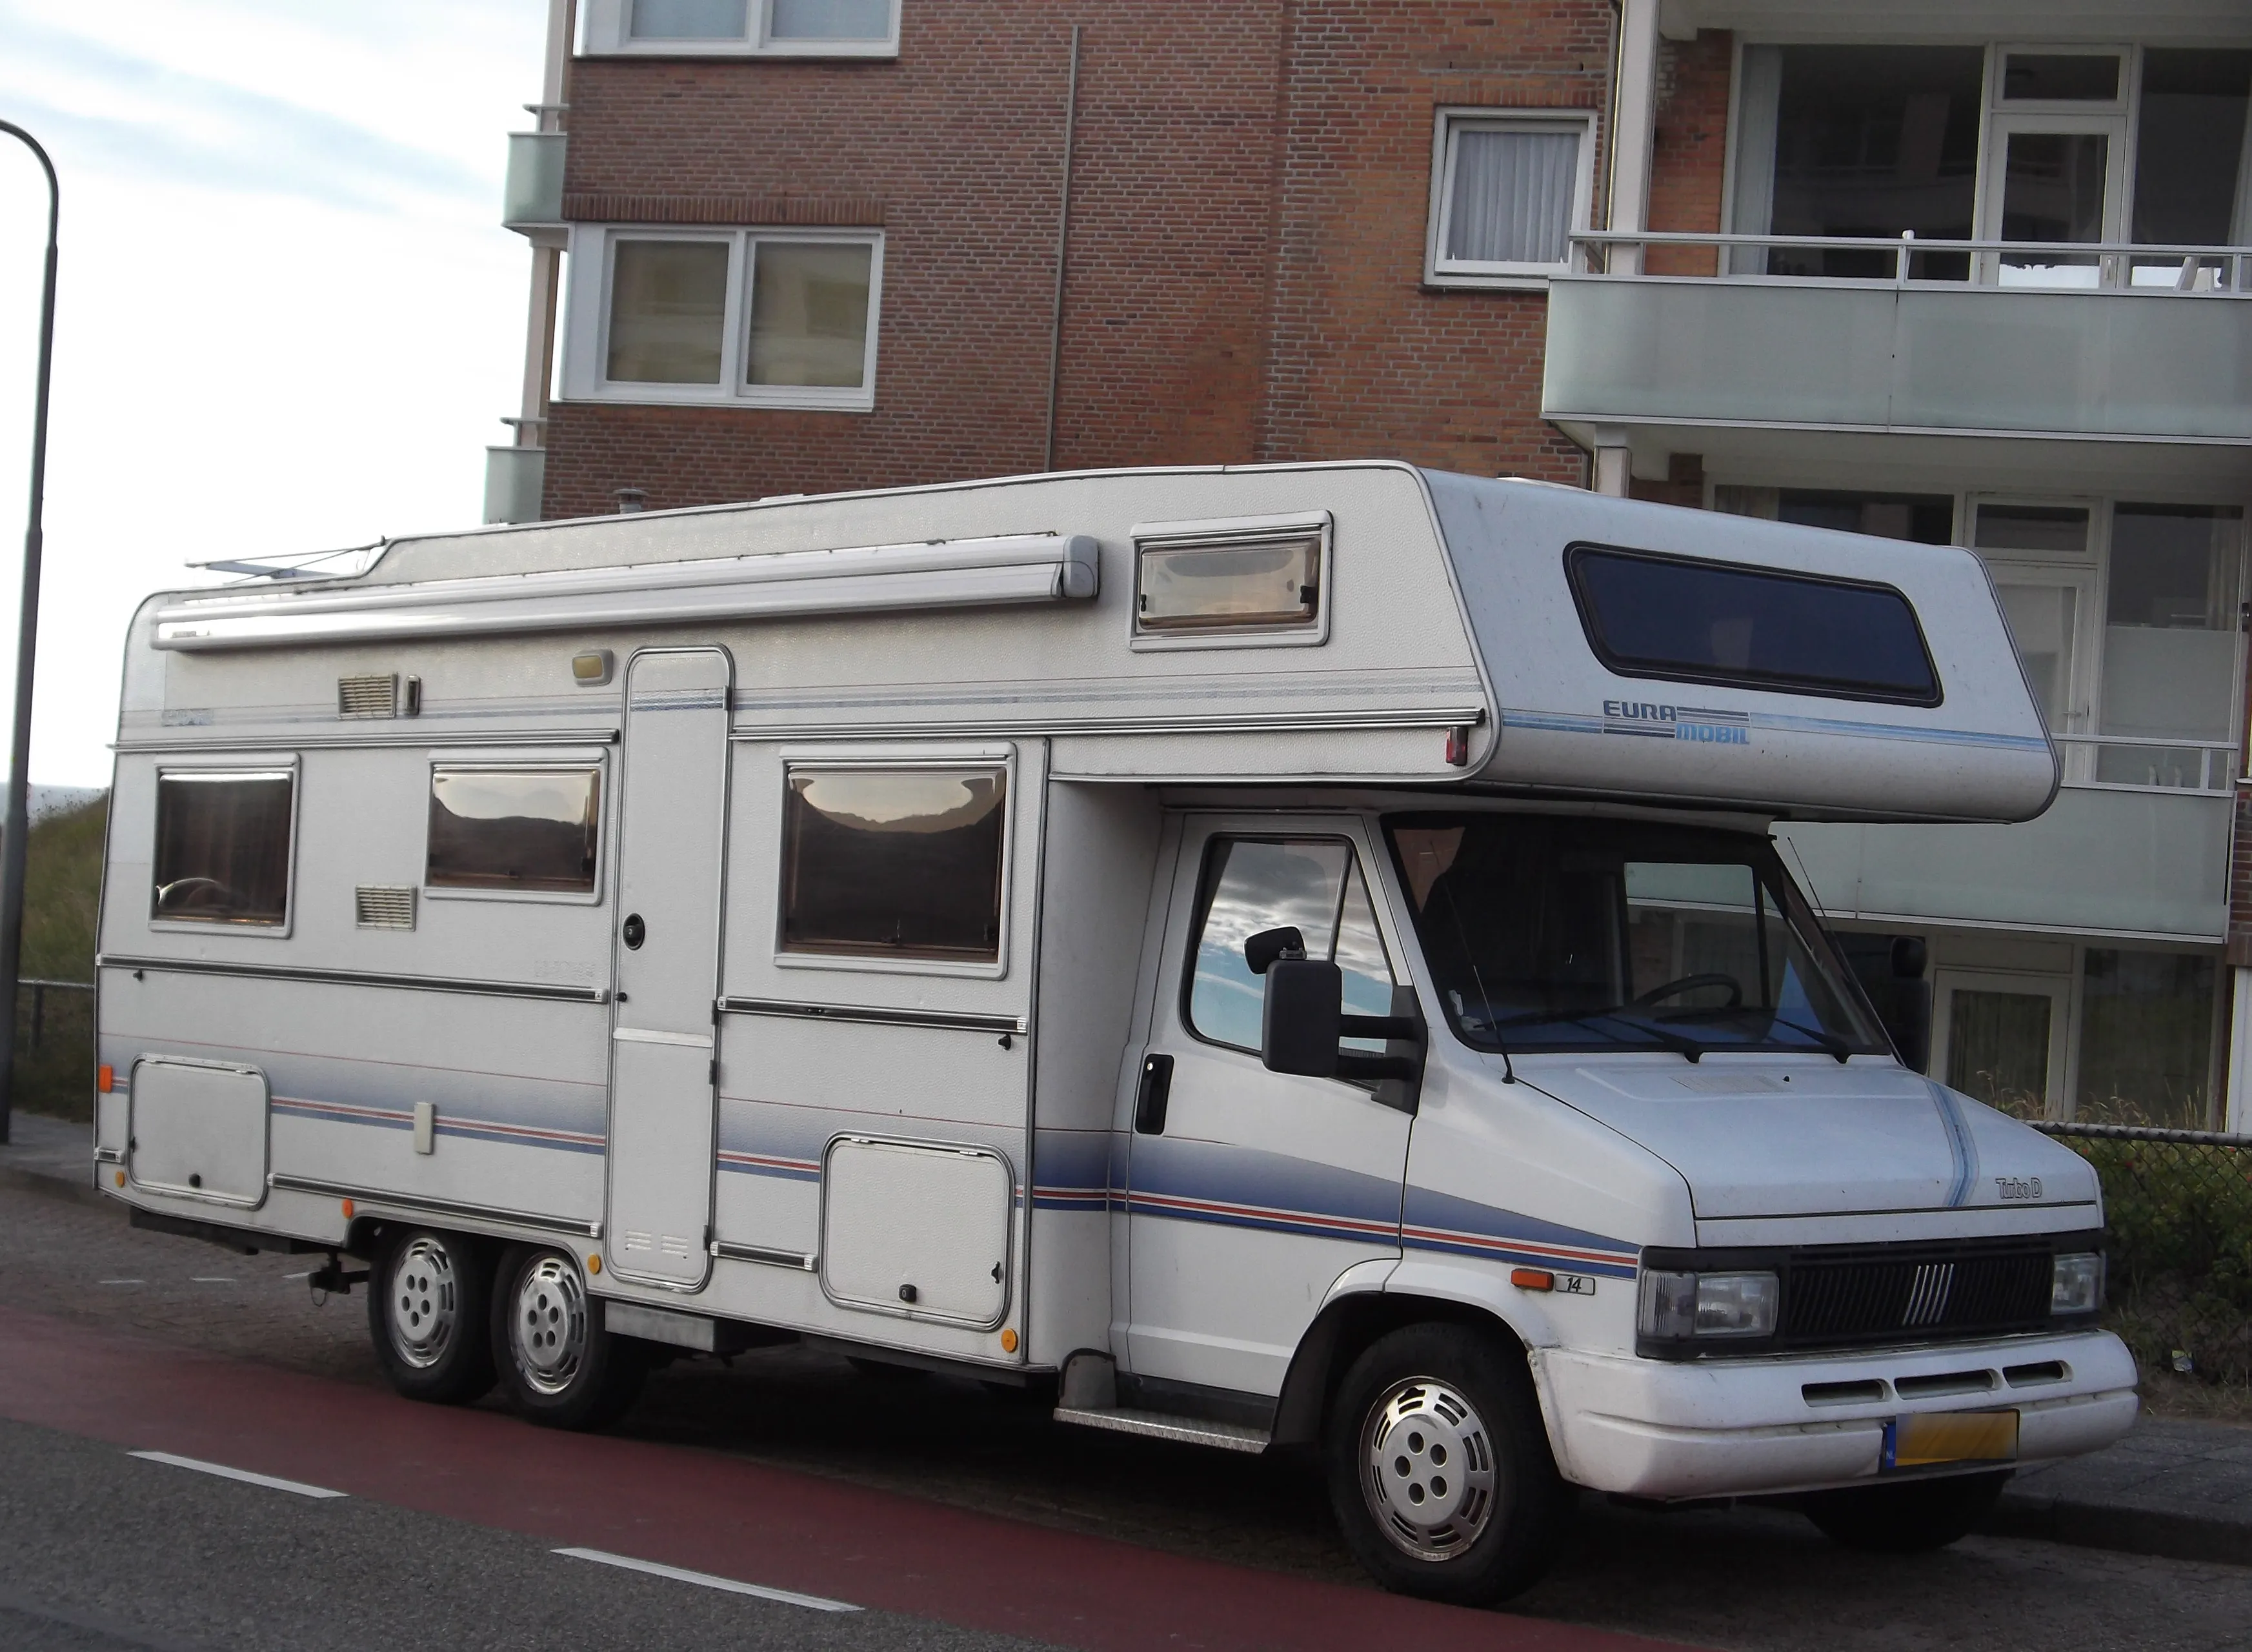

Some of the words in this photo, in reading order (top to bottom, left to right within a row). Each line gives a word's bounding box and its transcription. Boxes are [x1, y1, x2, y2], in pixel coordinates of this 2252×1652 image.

[1603, 700, 1676, 721] EURA
[1995, 1177, 2030, 1199] Turbo
[2031, 1177, 2042, 1198] D
[1567, 1277, 1582, 1292] 14
